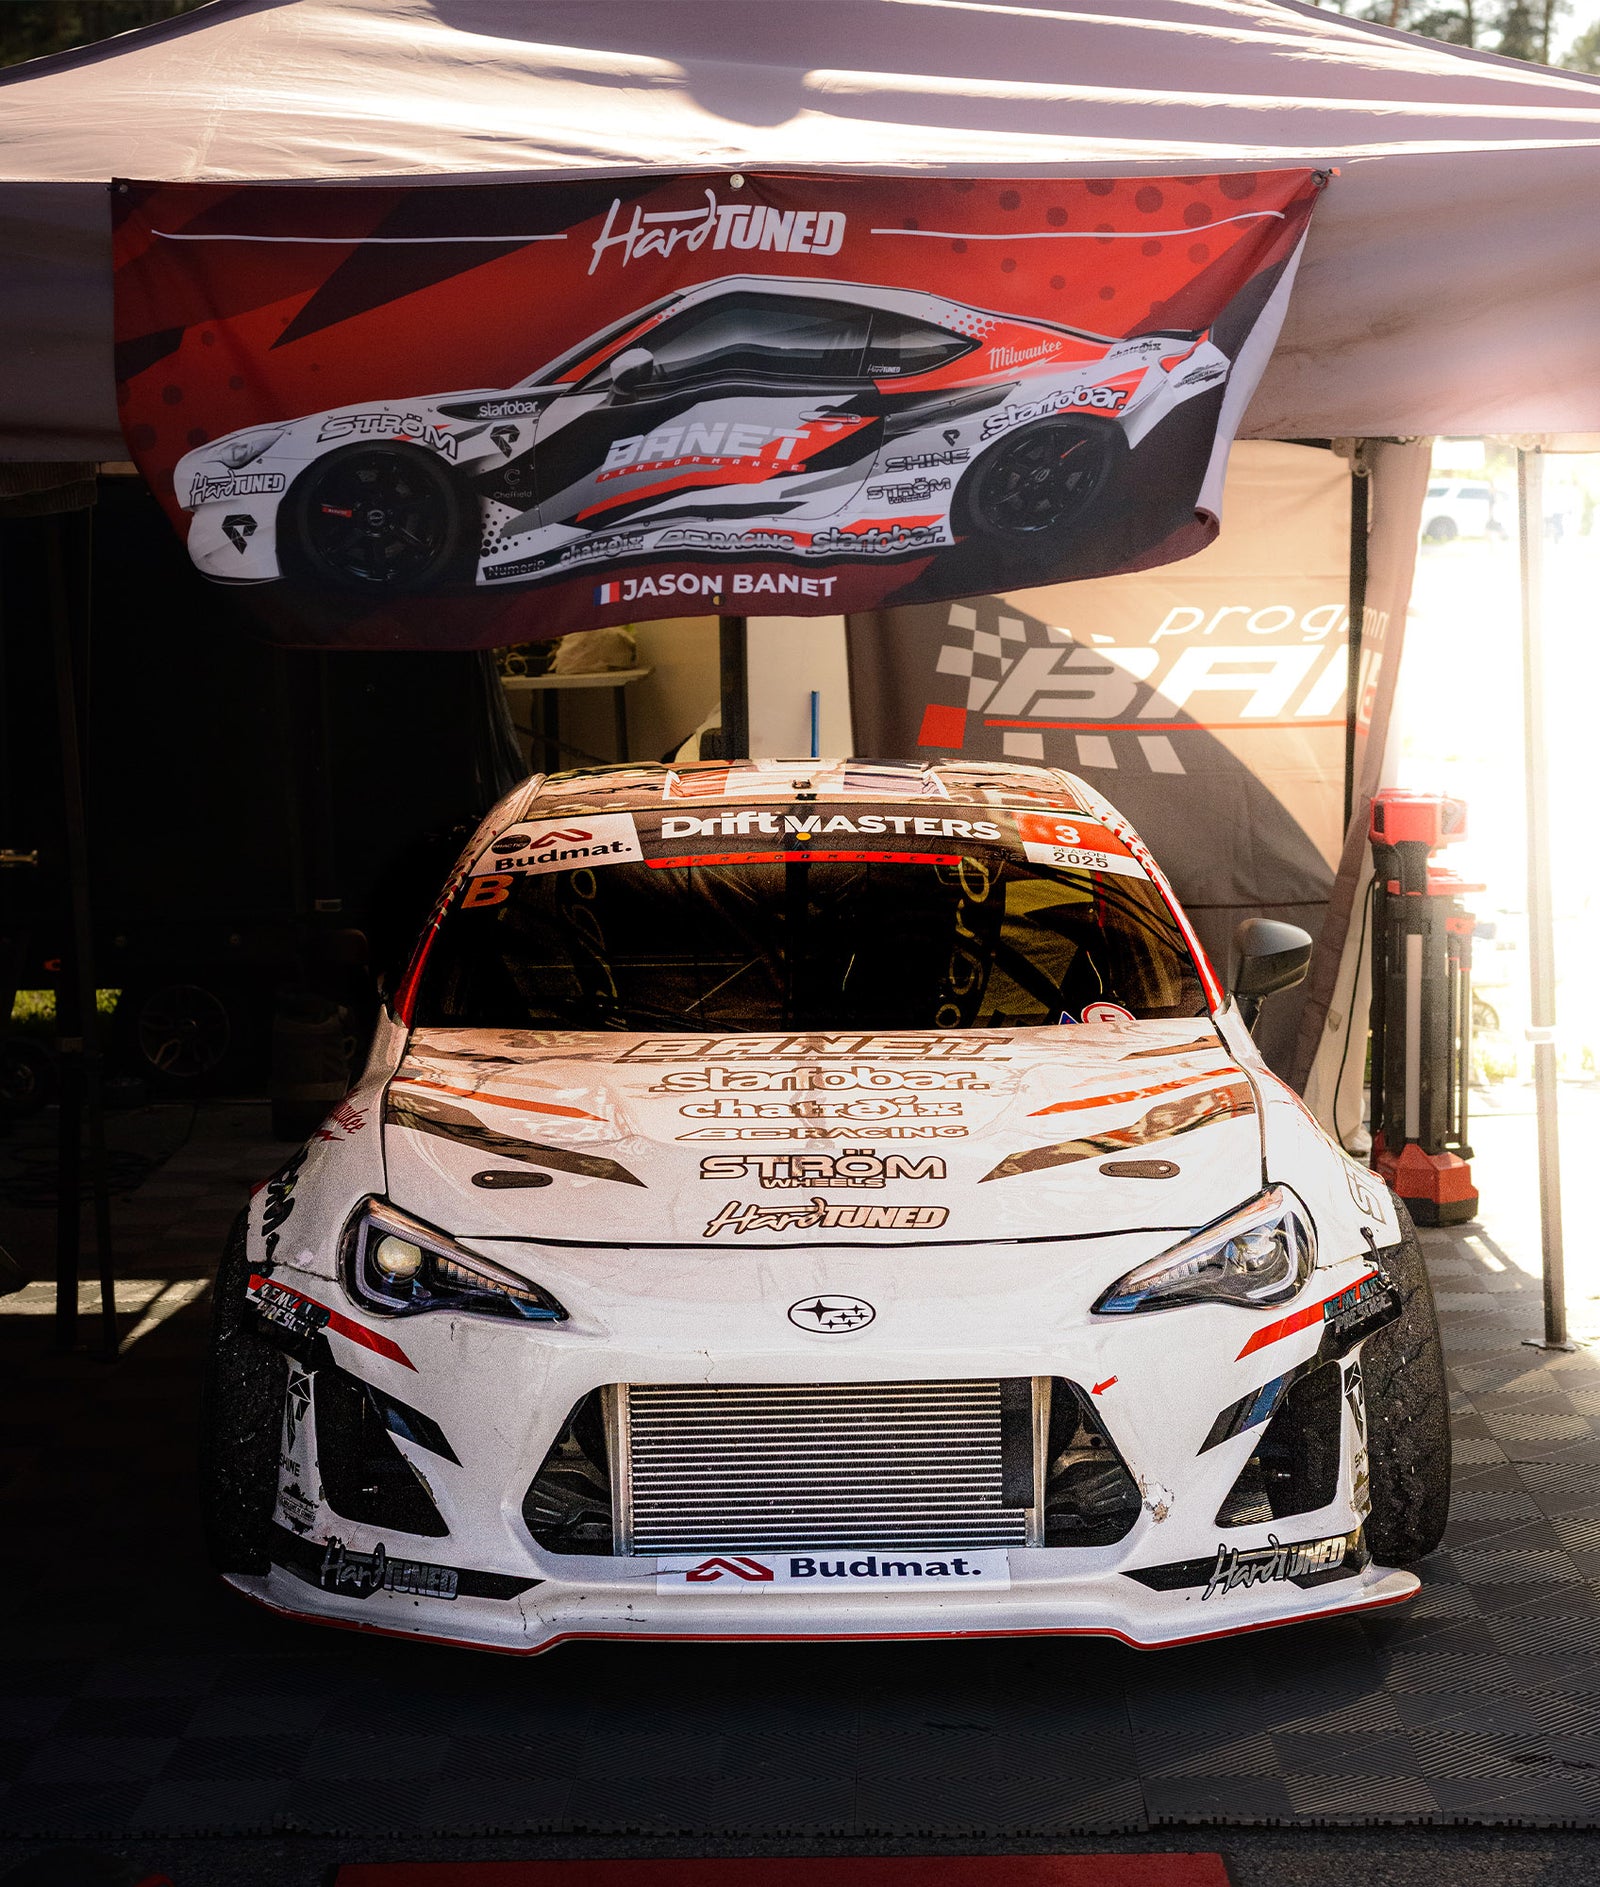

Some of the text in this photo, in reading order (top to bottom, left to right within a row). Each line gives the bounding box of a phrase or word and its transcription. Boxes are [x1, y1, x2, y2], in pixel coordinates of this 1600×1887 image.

[986, 339, 1063, 371] Milwaukee
[316, 413, 458, 459] STRÖM
[601, 422, 811, 473] BANET
[601, 454, 800, 481] PERFORMANCE
[885, 447, 970, 473] SHINE
[867, 477, 951, 499] STRÖM
[622, 573, 837, 601] JASON BANET
[1054, 824, 1081, 845] 3
[495, 840, 632, 872] Budmat.
[1053, 851, 1109, 868] 2025
[461, 874, 514, 909] B
[620, 1035, 1014, 1058] BANET
[700, 1148, 947, 1181] STRÖM
[760, 1177, 886, 1189] WHEELS
[789, 1556, 981, 1578] Budmat.
